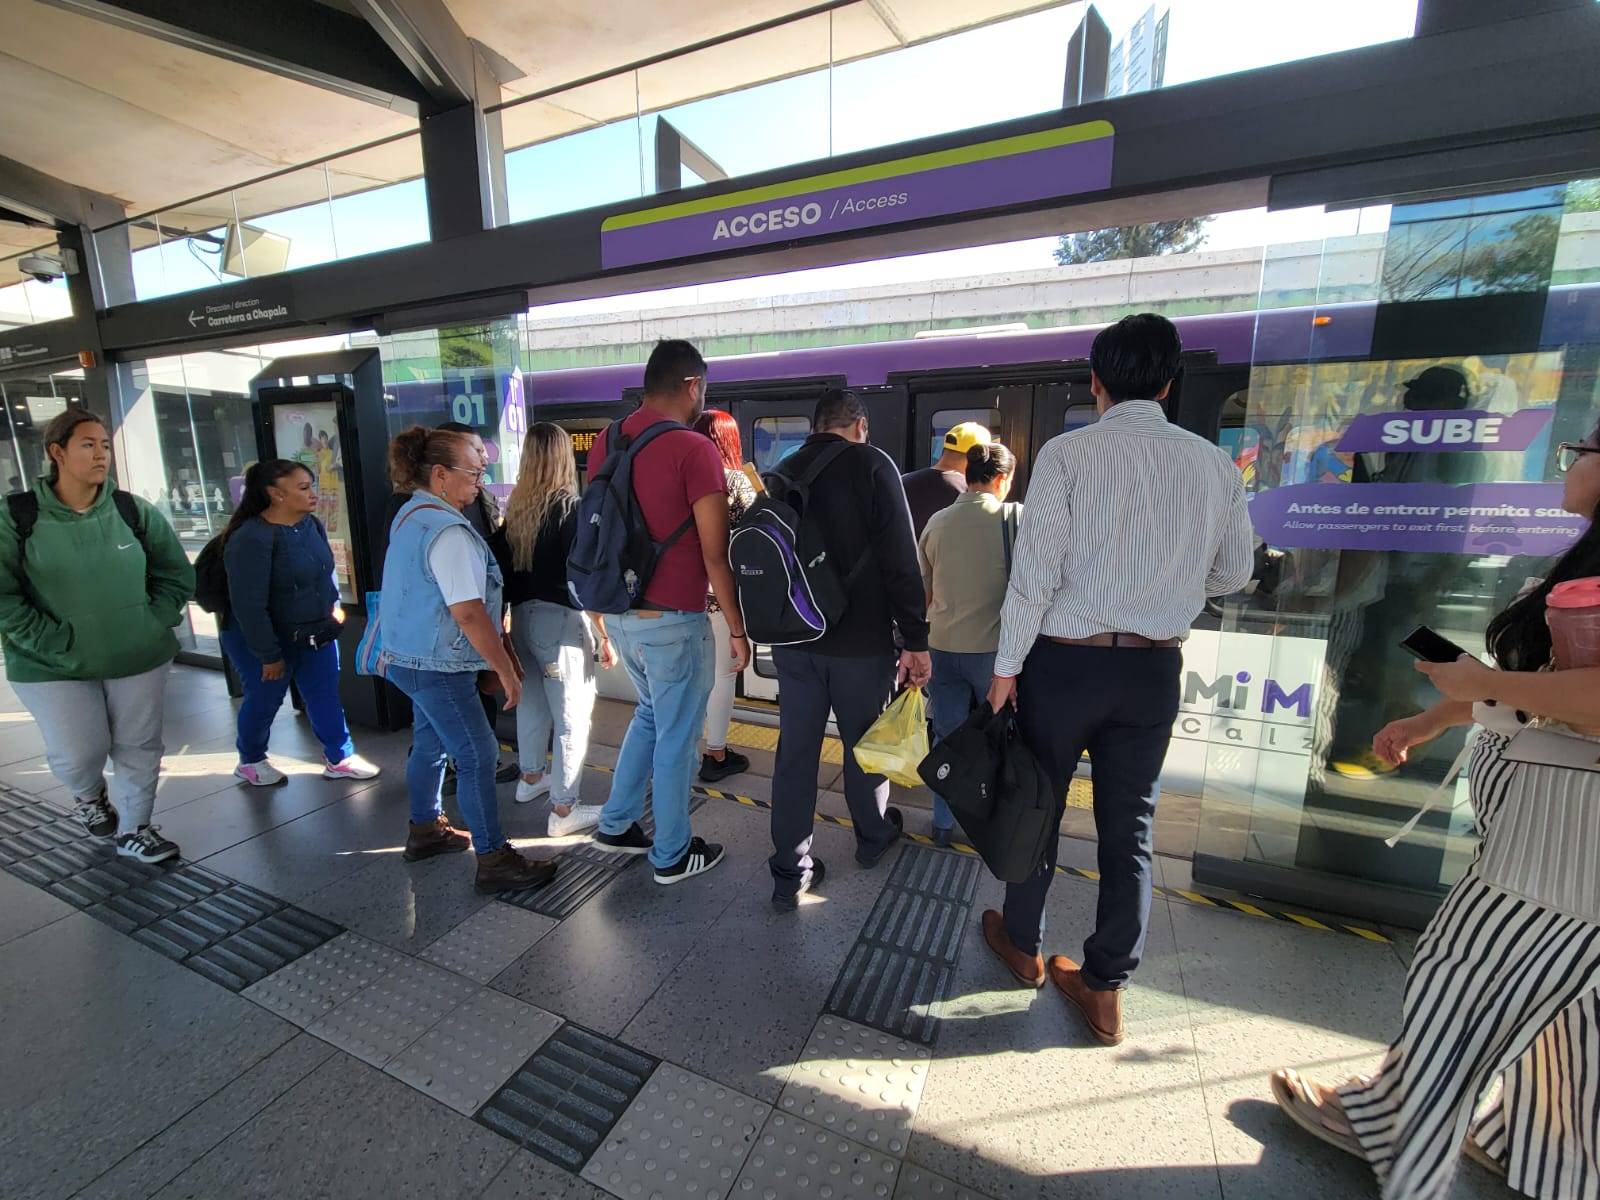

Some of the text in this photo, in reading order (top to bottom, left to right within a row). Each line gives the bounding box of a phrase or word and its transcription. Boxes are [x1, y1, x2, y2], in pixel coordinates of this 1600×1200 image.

[713, 203, 822, 240] ACCESO
[208, 304, 288, 327] Carretera a Chapala
[1381, 417, 1503, 445] SUBE
[1287, 502, 1342, 515] Antes
[1345, 502, 1370, 515] de
[1373, 504, 1440, 516] entrar
[1443, 503, 1531, 519] permita
[1282, 520, 1316, 530] Allow
[1317, 522, 1391, 533] passengers
[1392, 523, 1406, 532] to
[1408, 524, 1433, 532] exit
[1468, 523, 1518, 534] before
[1517, 525, 1580, 537] entering
